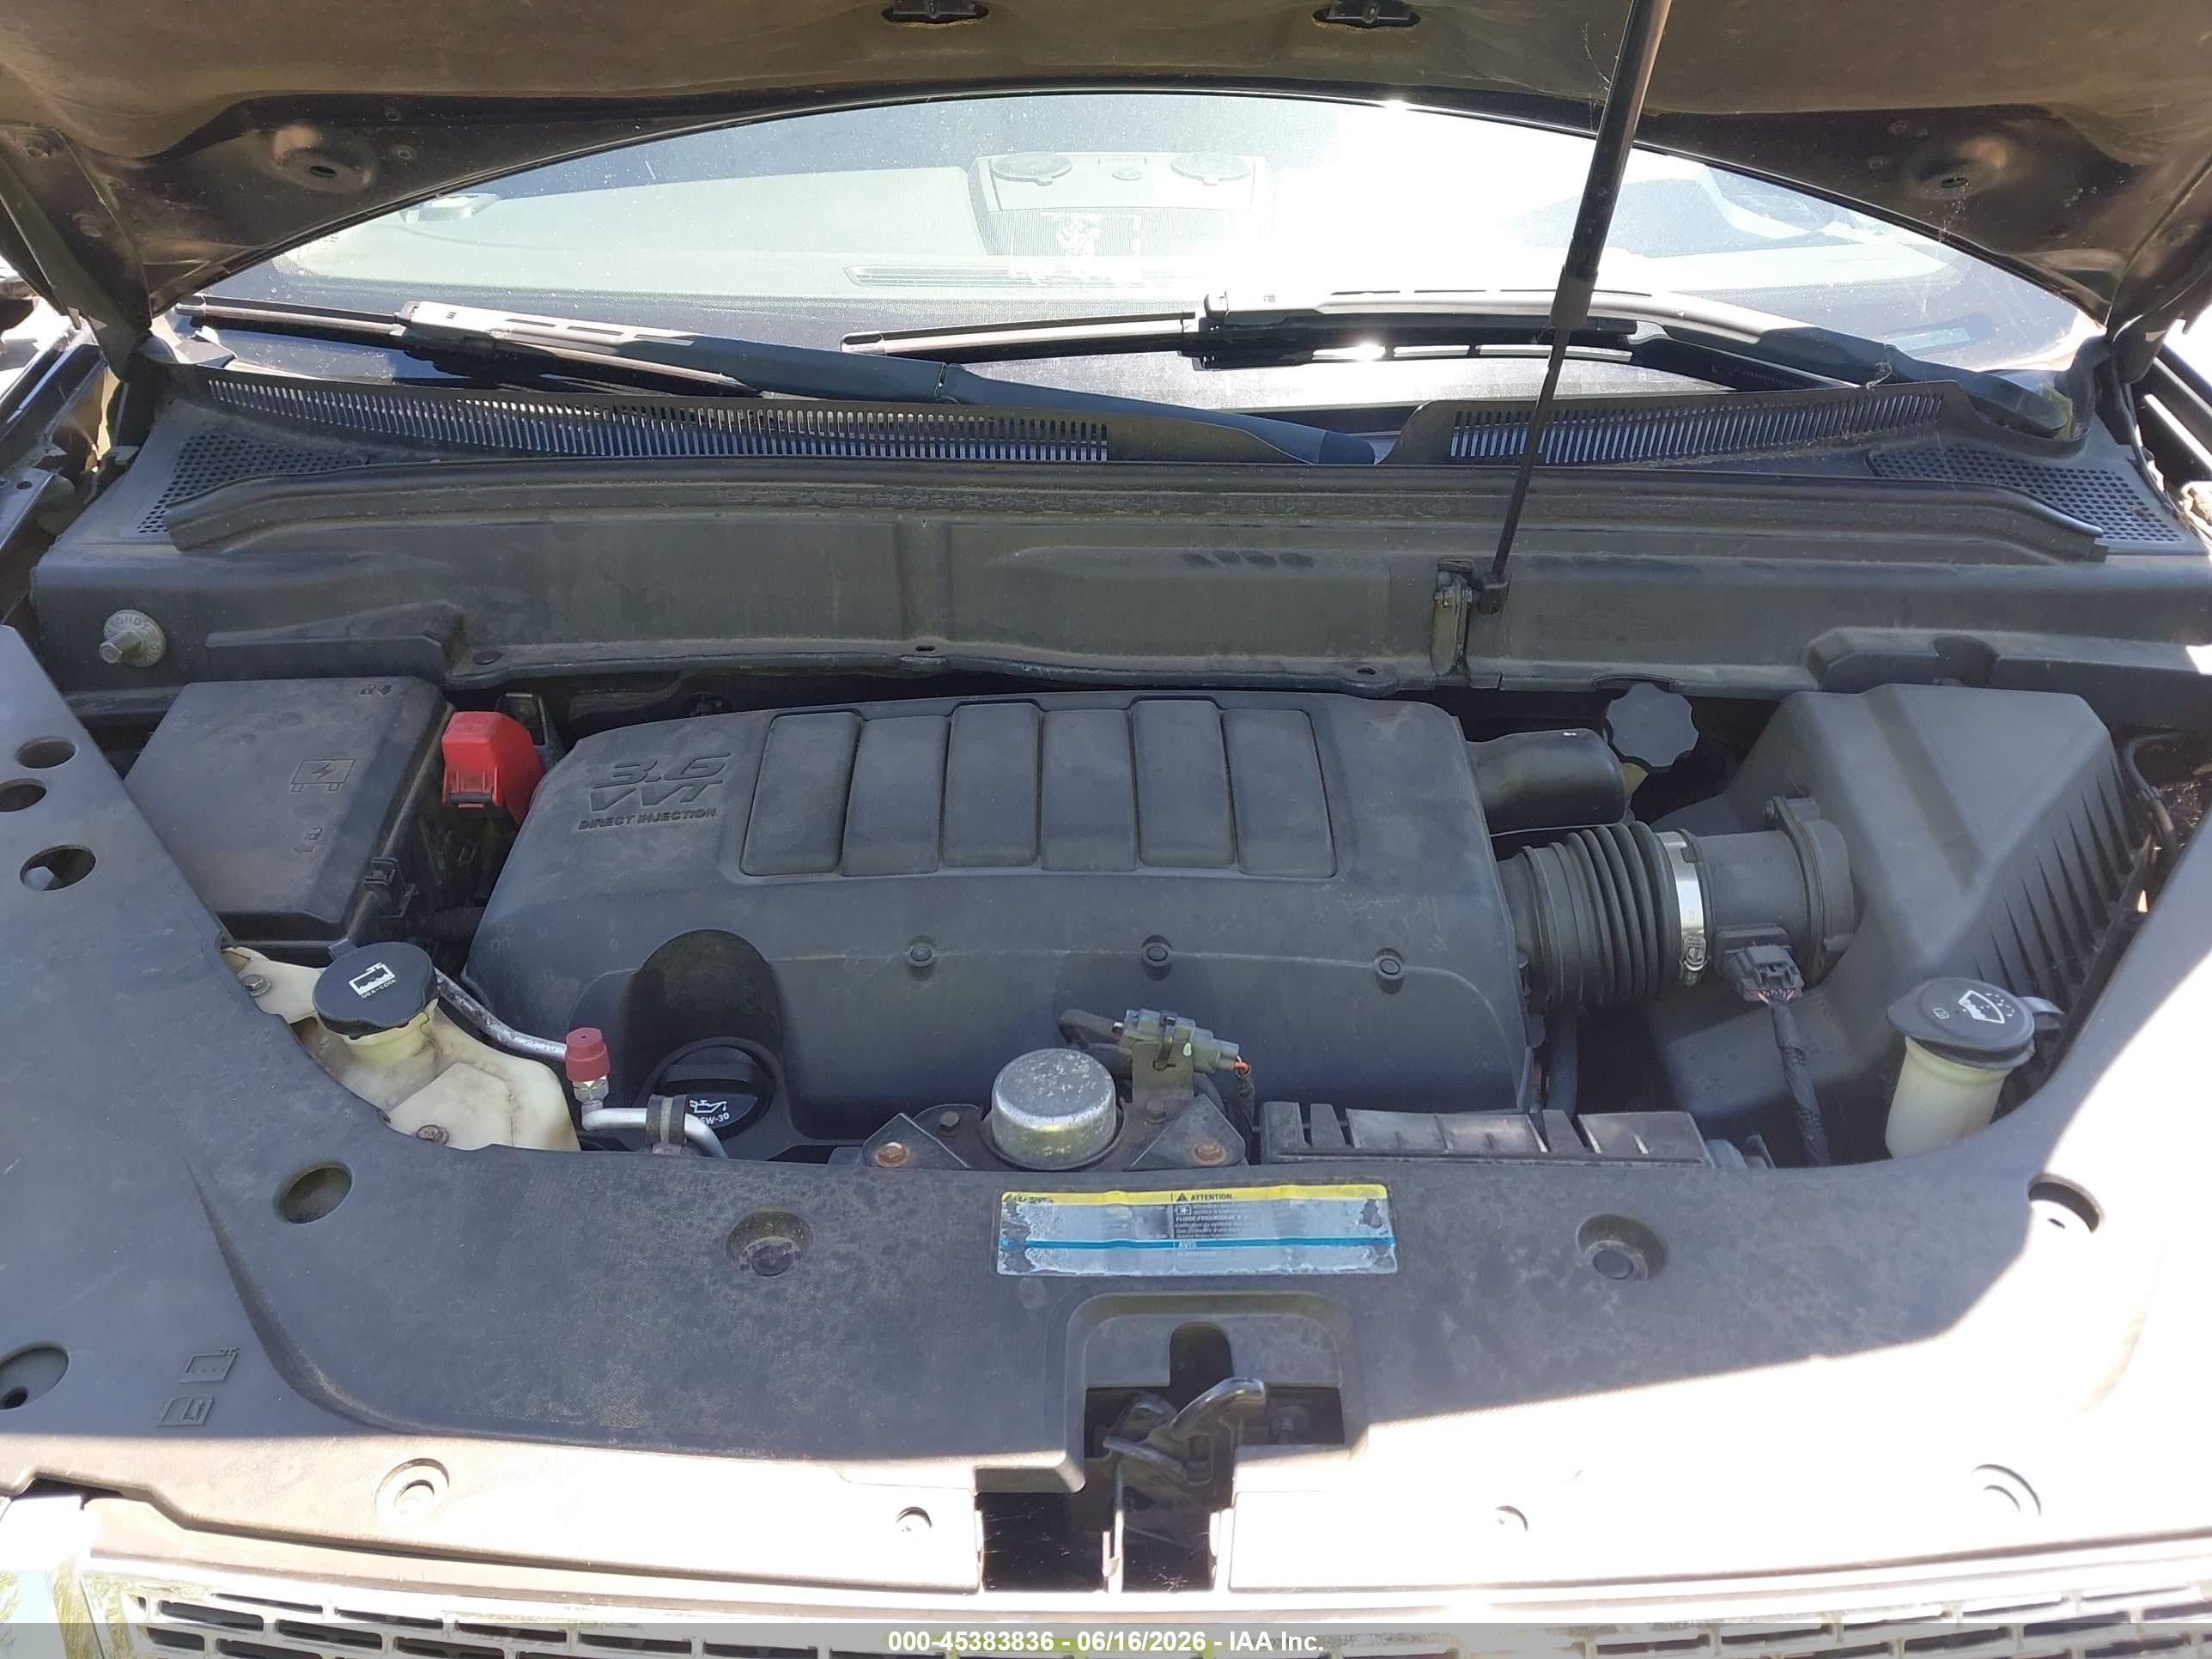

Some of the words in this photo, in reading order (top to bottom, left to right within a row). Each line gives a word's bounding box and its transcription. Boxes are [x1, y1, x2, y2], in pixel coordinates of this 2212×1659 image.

[116, 614, 143, 626] GND
[592, 752, 732, 789] 3.6
[590, 780, 724, 812] VVT
[577, 815, 635, 830] DIRECT
[637, 807, 717, 824] INJECTION
[1190, 1193, 1232, 1201] ATTENTION
